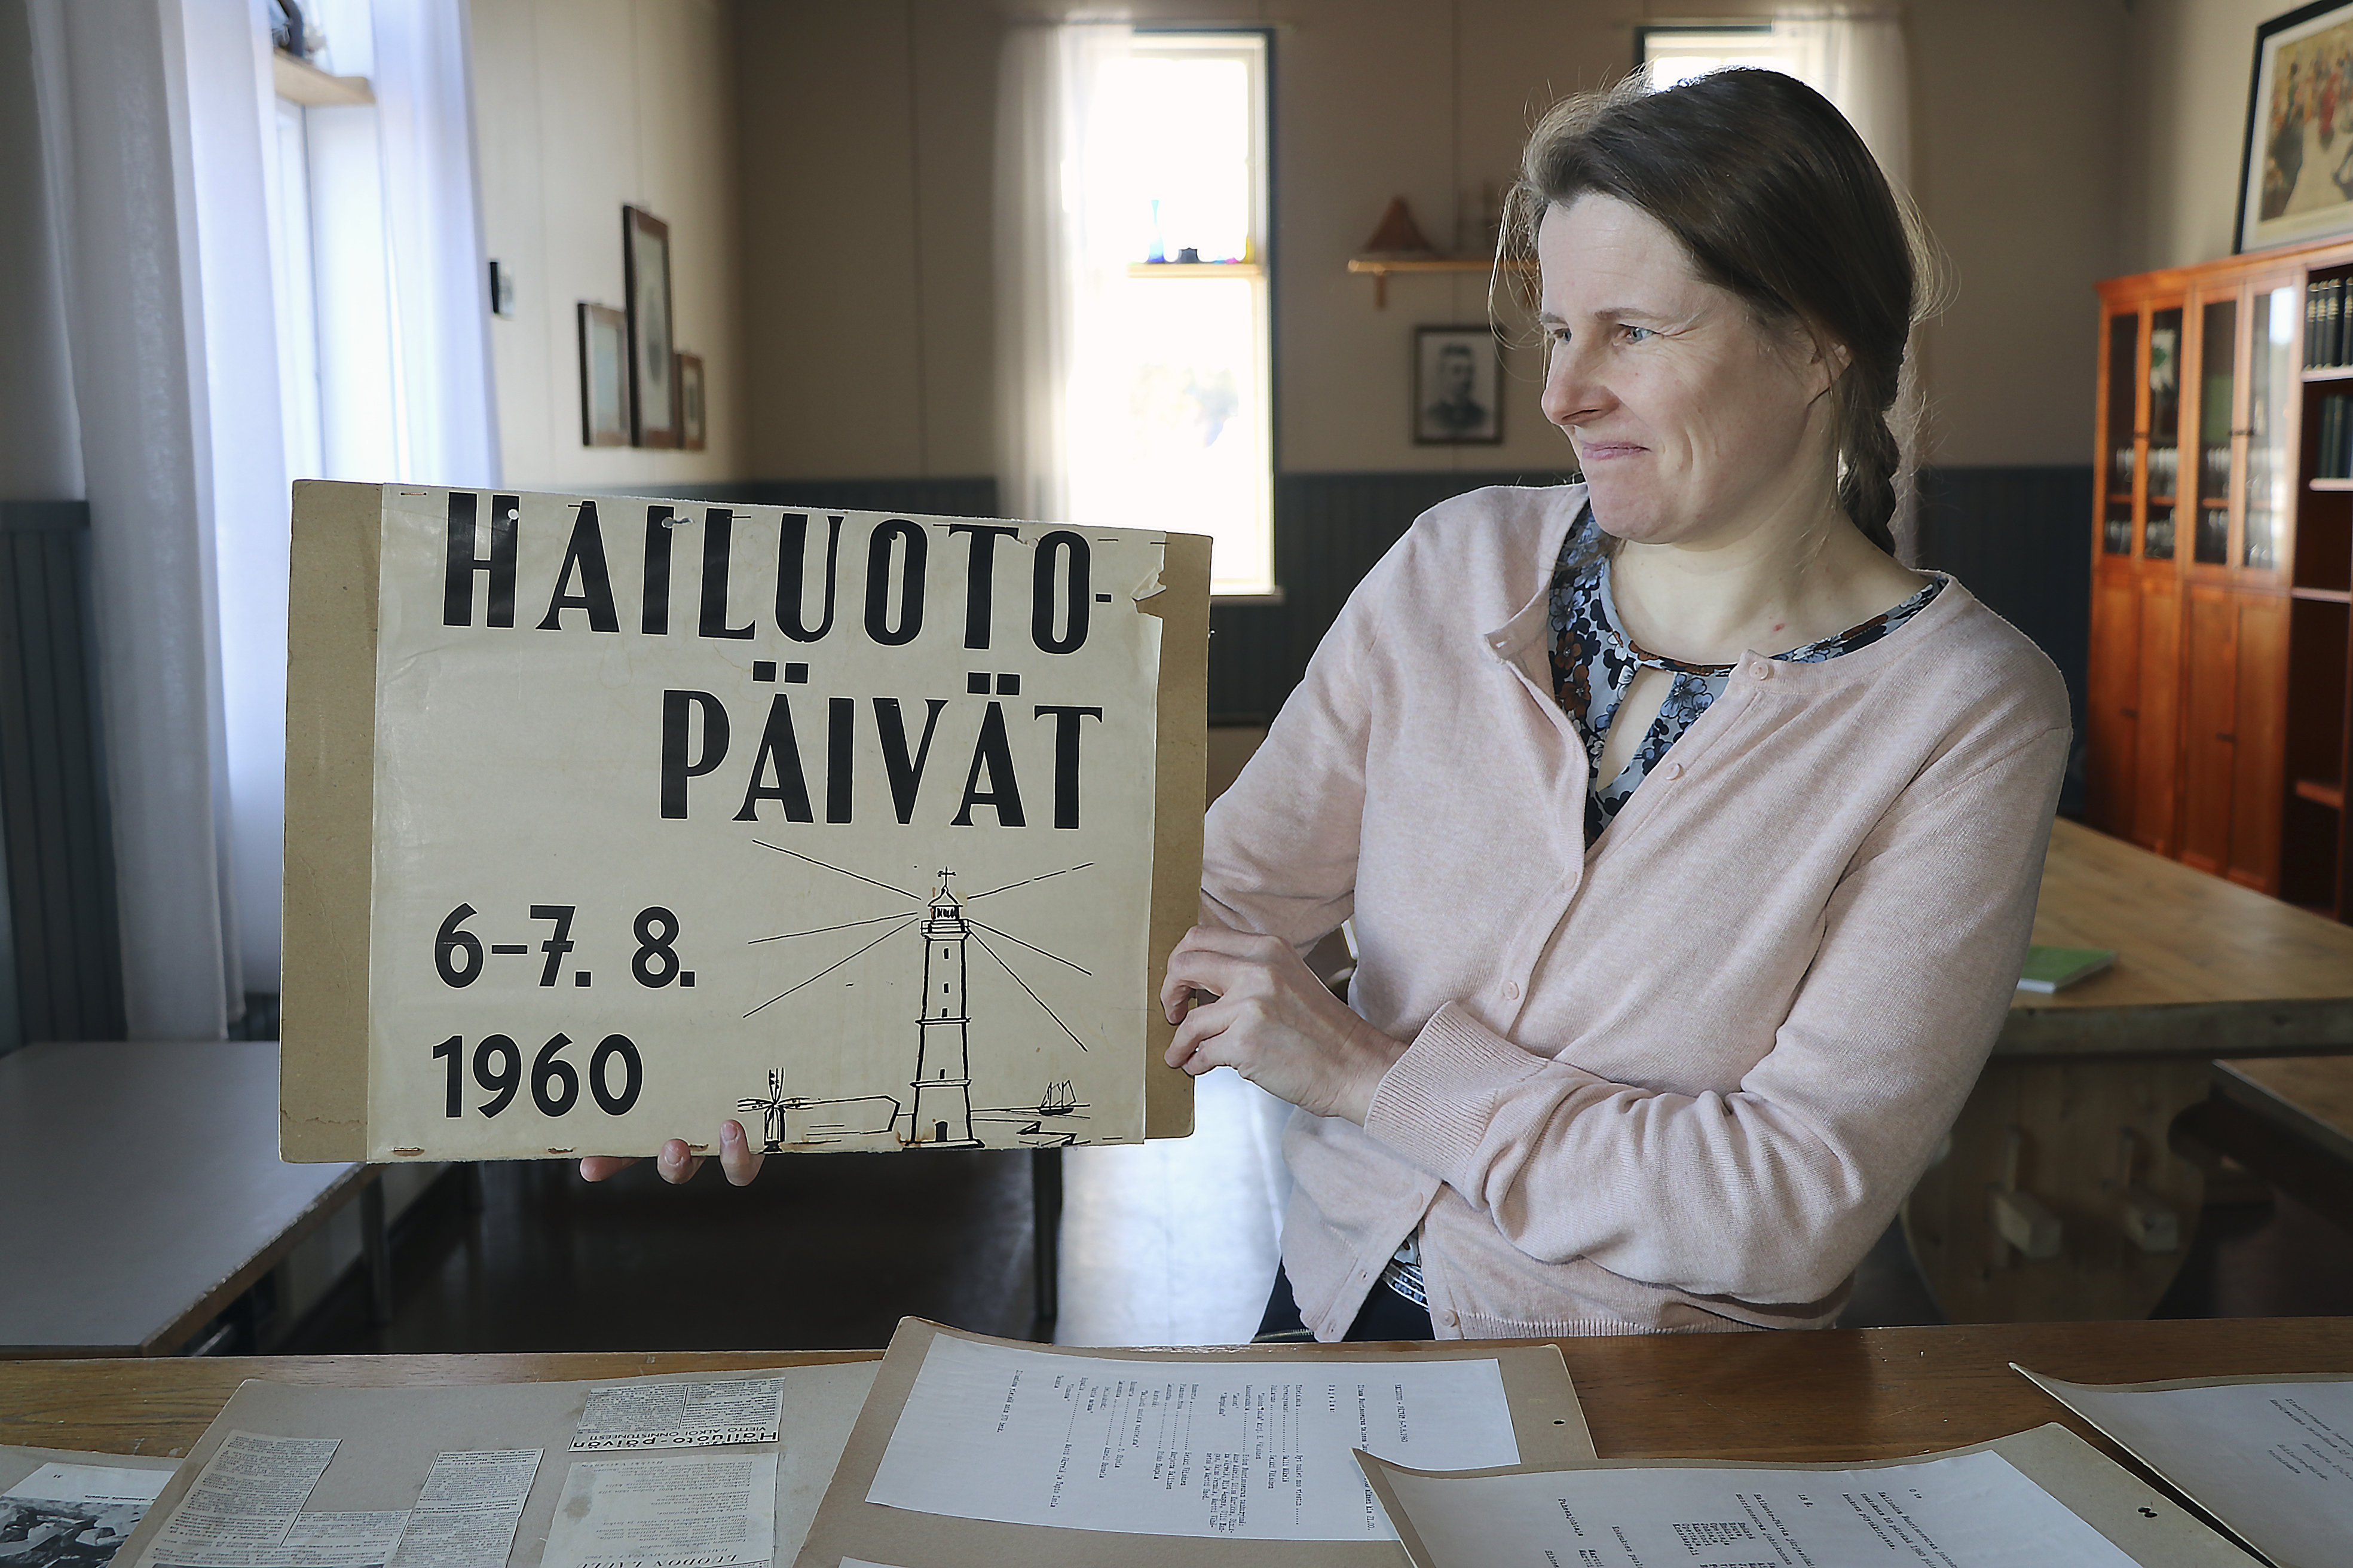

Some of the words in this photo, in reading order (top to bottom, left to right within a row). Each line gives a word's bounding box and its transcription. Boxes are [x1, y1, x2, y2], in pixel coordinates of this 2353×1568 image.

[442, 492, 1113, 655] HAILUOTO-
[660, 662, 1103, 830] PÄIVÄT
[631, 906, 696, 988] 8.
[432, 1033, 643, 1118] 1960
[571, 1432, 778, 1448] Hailuoto-päivän
[589, 1431, 680, 1440] ONNISTUNEESTI
[1558, 1498, 1585, 1537] Puheenjohtaja
[1858, 1514, 1896, 1550] pöytäkirjasta.
[1901, 1515, 1938, 1549] Nuorisoseuran
[1611, 1526, 1633, 1552] Kokouksen
[1910, 1545, 1926, 1557] 1960
[653, 1555, 737, 1567] LUODON
[1544, 1550, 1560, 1568] Sihtee
